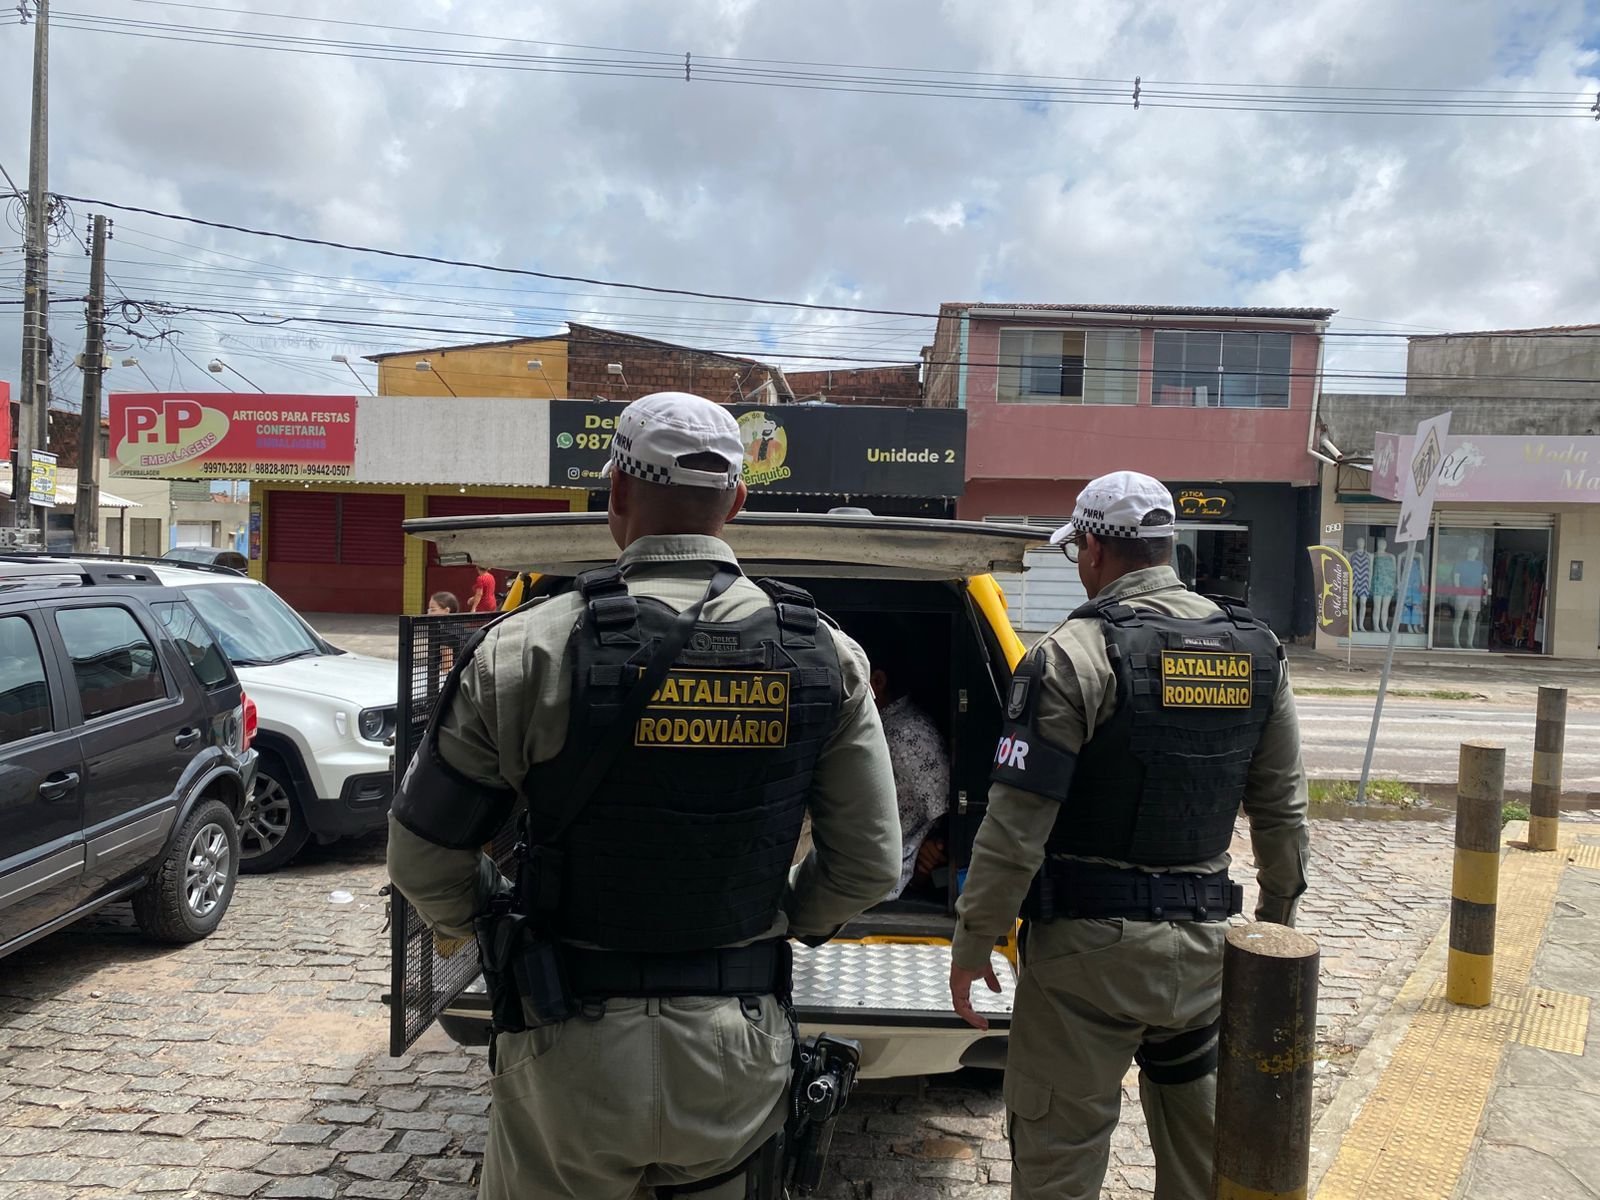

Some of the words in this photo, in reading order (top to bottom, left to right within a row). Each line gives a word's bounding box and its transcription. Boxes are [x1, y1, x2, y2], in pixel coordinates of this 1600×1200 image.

[232, 410, 278, 421] ARTIGOS
[281, 411, 309, 422] PARA
[311, 411, 350, 423] FESTAS
[585, 415, 620, 429] Del
[256, 424, 326, 436] CONFEITARIA
[140, 432, 217, 466] EMBALAGENS
[576, 433, 612, 450] 987
[866, 448, 940, 463] Unidade
[944, 449, 956, 463] 2
[203, 462, 247, 474] 99970-2382
[255, 463, 299, 475] 98828-8073
[306, 464, 350, 476] 99442-0507
[1560, 469, 1600, 489] Ma
[1083, 507, 1104, 520] PMRN
[1332, 594, 1342, 617] Mel
[1165, 656, 1249, 677] BATALHÃO
[651, 676, 785, 705] ATALHÃO
[1165, 684, 1249, 705] RODOVIÁRIO
[639, 715, 783, 744] RODOVIÁRIO
